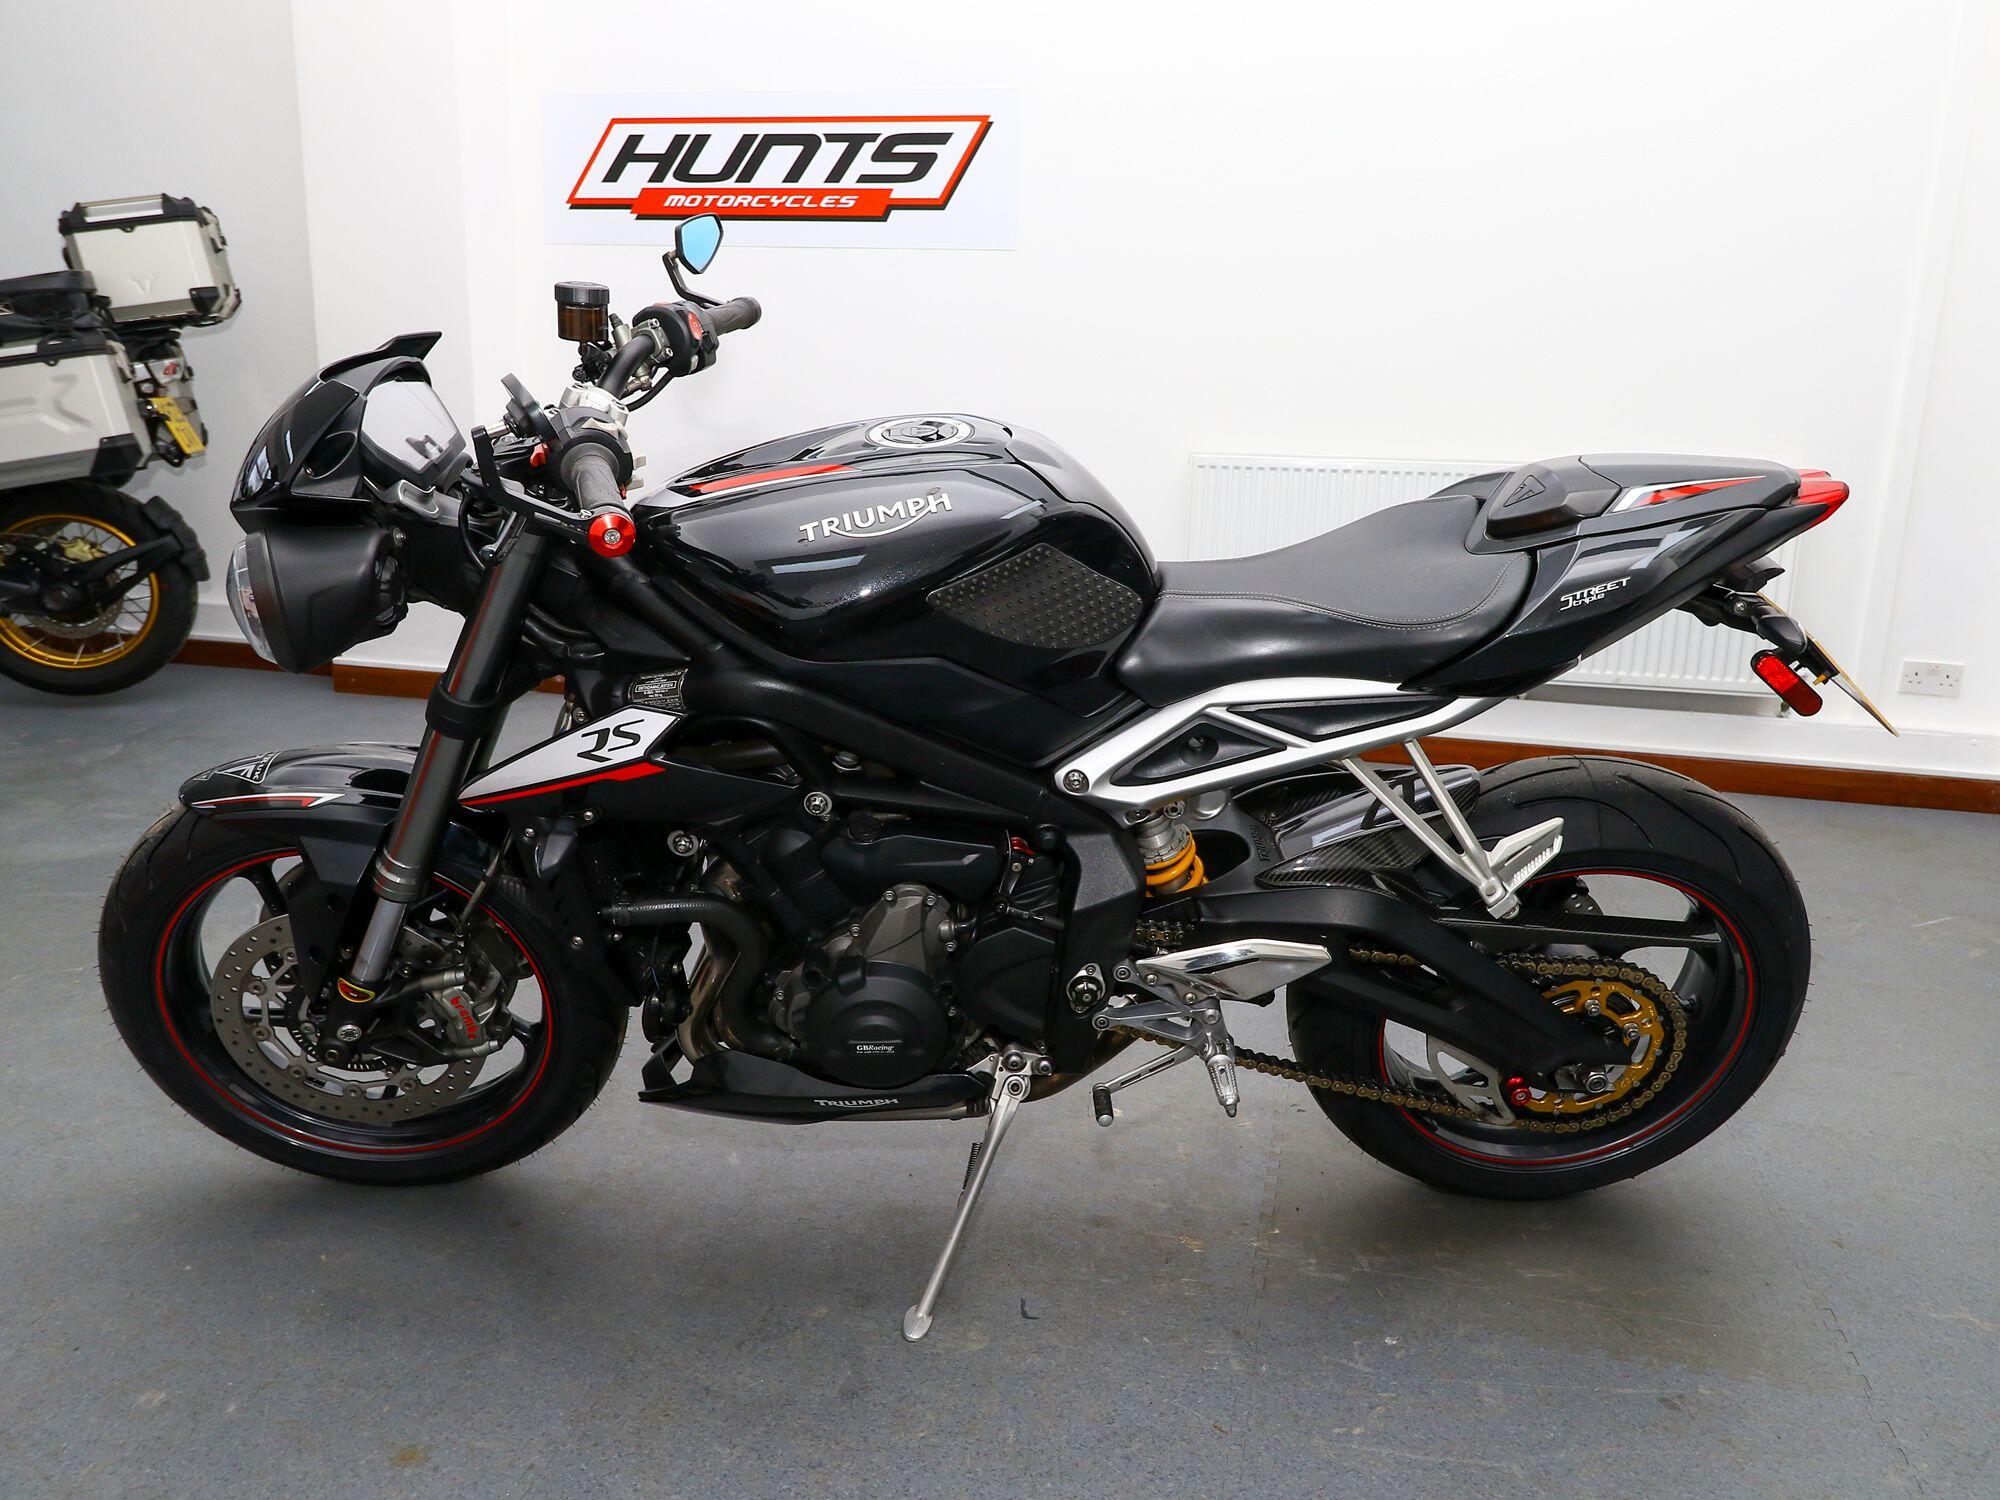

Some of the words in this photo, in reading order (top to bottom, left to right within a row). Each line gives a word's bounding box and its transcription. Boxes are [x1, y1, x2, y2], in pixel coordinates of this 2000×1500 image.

[601, 132, 954, 184] HUNTS
[663, 194, 858, 209] MOTORCYCLES
[800, 493, 952, 542] TRIUMPH
[1559, 576, 1631, 611] STREET
[577, 719, 645, 763] RS
[814, 1099, 899, 1108] TRIUMPH
